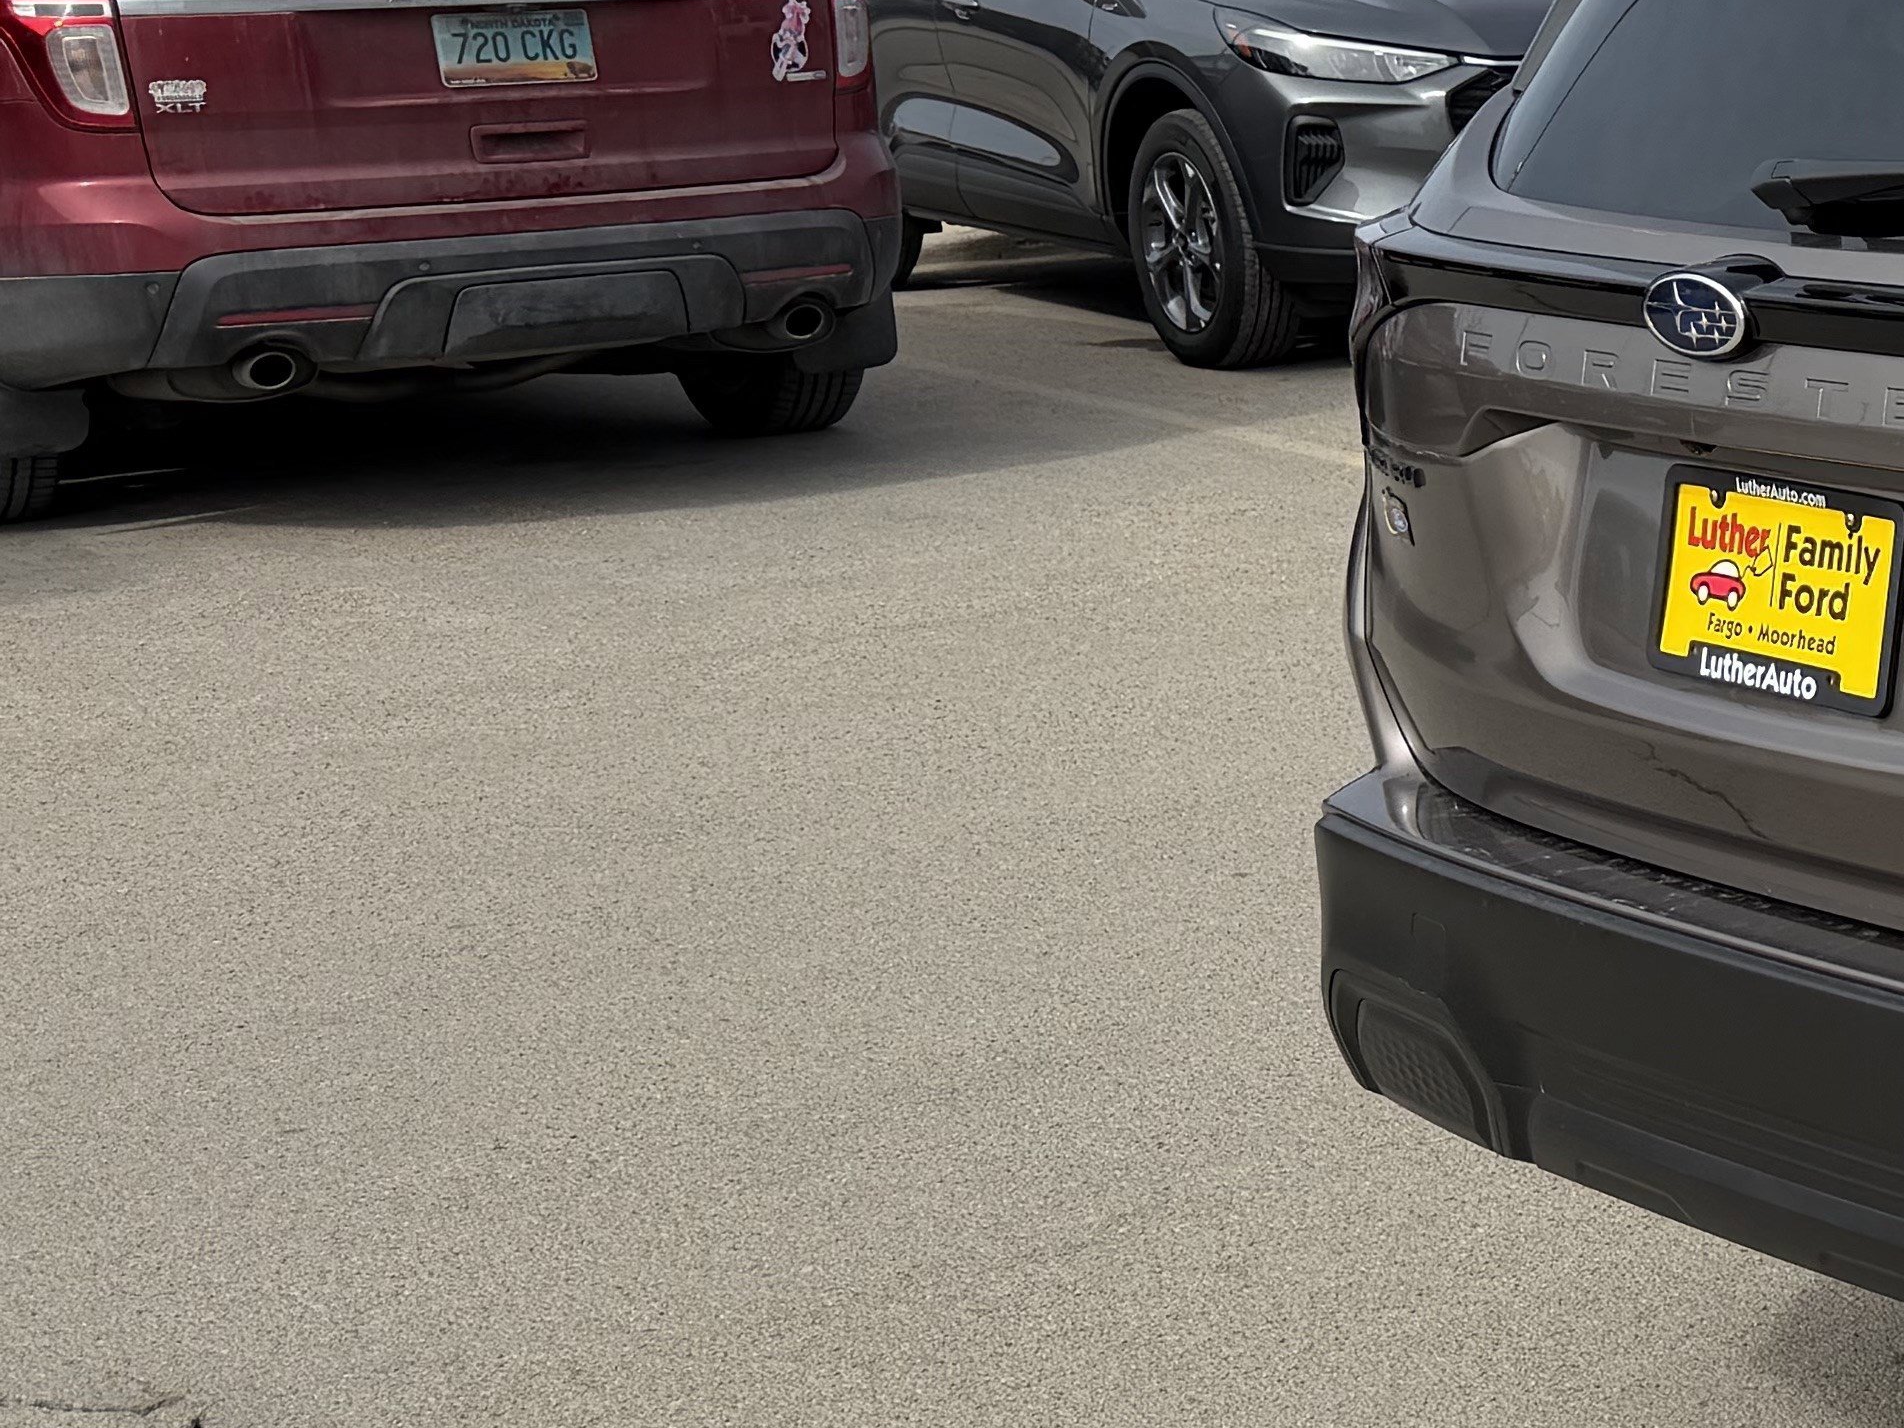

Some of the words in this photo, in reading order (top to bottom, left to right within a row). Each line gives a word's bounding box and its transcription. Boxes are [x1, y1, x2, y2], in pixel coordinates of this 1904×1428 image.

[451, 31, 511, 64] 720
[520, 28, 578, 61] CKG
[155, 101, 207, 114] XLT
[1735, 476, 1827, 508] LutherAuto.com
[1687, 506, 1771, 558] Luther
[1782, 524, 1882, 586] Family
[1778, 572, 1851, 621] Ford
[1707, 612, 1743, 640] Fargo
[1757, 623, 1836, 656] Moorhead
[1699, 646, 1818, 700] LutherAuto
